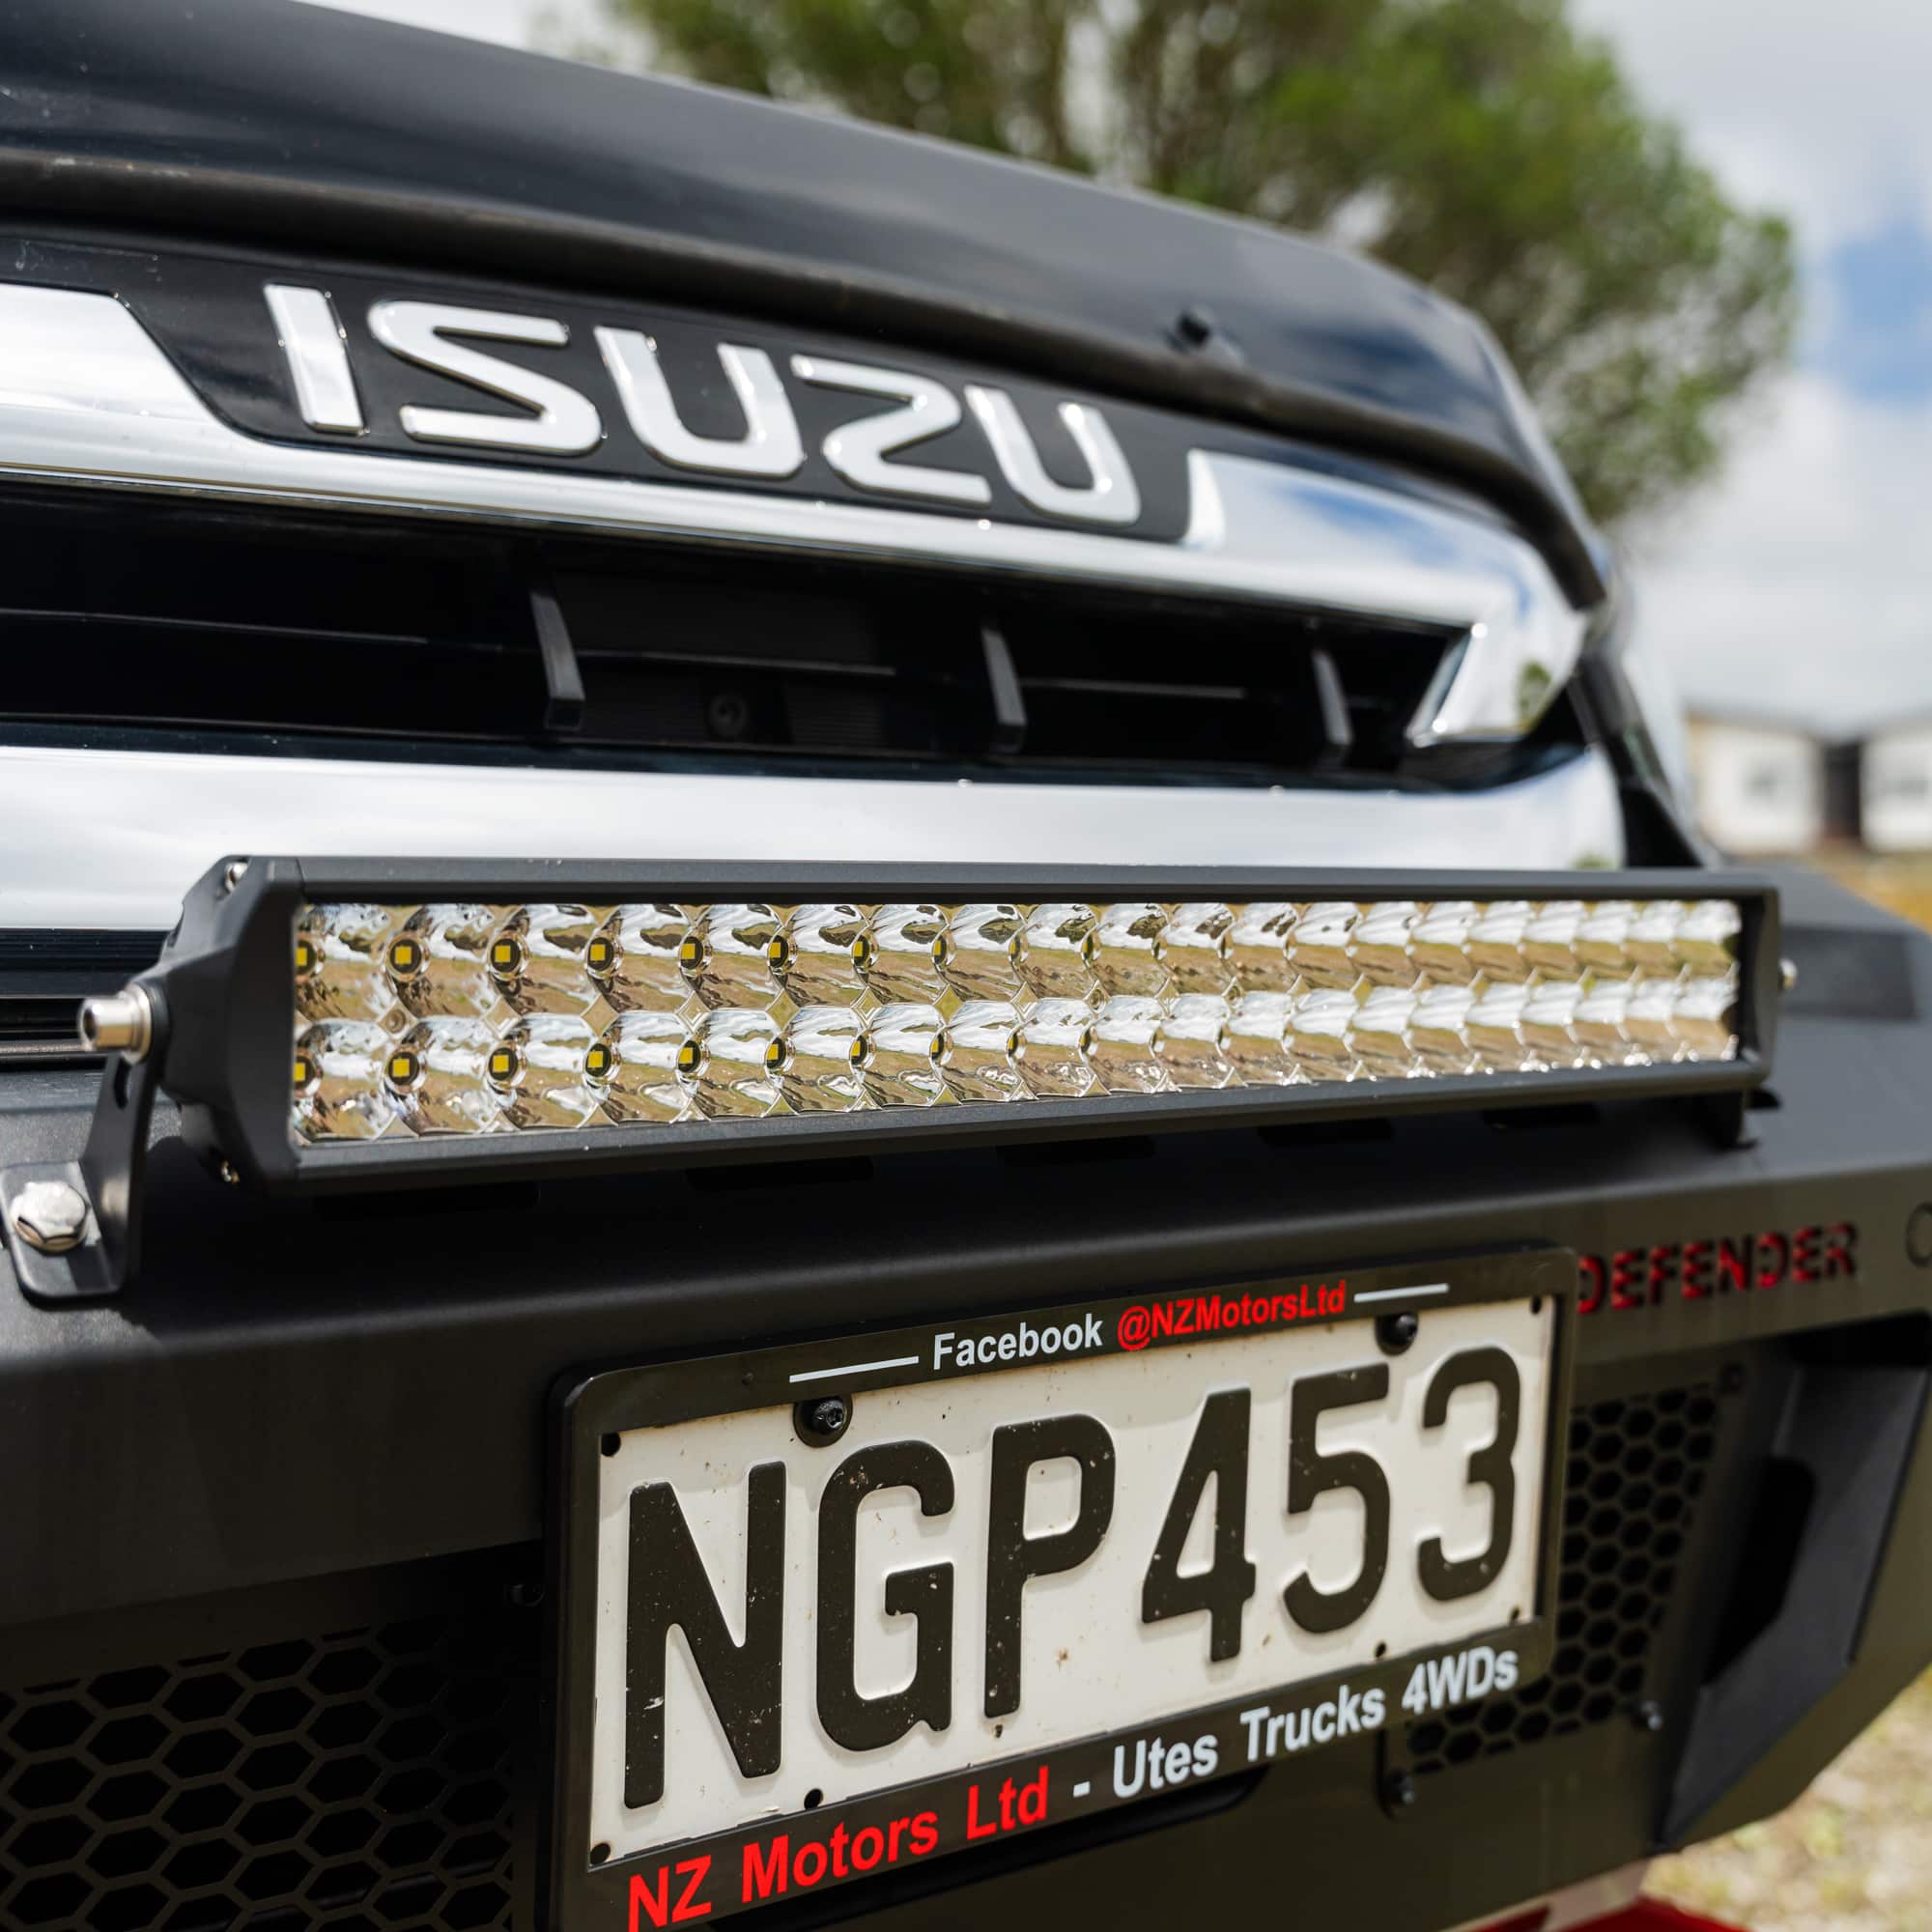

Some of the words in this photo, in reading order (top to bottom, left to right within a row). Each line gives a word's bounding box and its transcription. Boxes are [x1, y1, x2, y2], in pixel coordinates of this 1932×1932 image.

[263, 284, 1142, 526] ISUZU
[932, 1313, 1103, 1371] Facebook
[1117, 1280, 1347, 1352] @NZMotorsLtd
[1577, 1222, 1860, 1315] DEFENDER
[624, 1346, 1521, 1810] NGP453
[627, 1854, 713, 1932] NZ
[741, 1810, 939, 1905] Motors
[966, 1765, 1049, 1841] Ltd
[1072, 1781, 1091, 1798] -
[1113, 1733, 1218, 1798] Utes
[1239, 1684, 1385, 1762] Trucks
[1402, 1646, 1519, 1715] 4WDs
